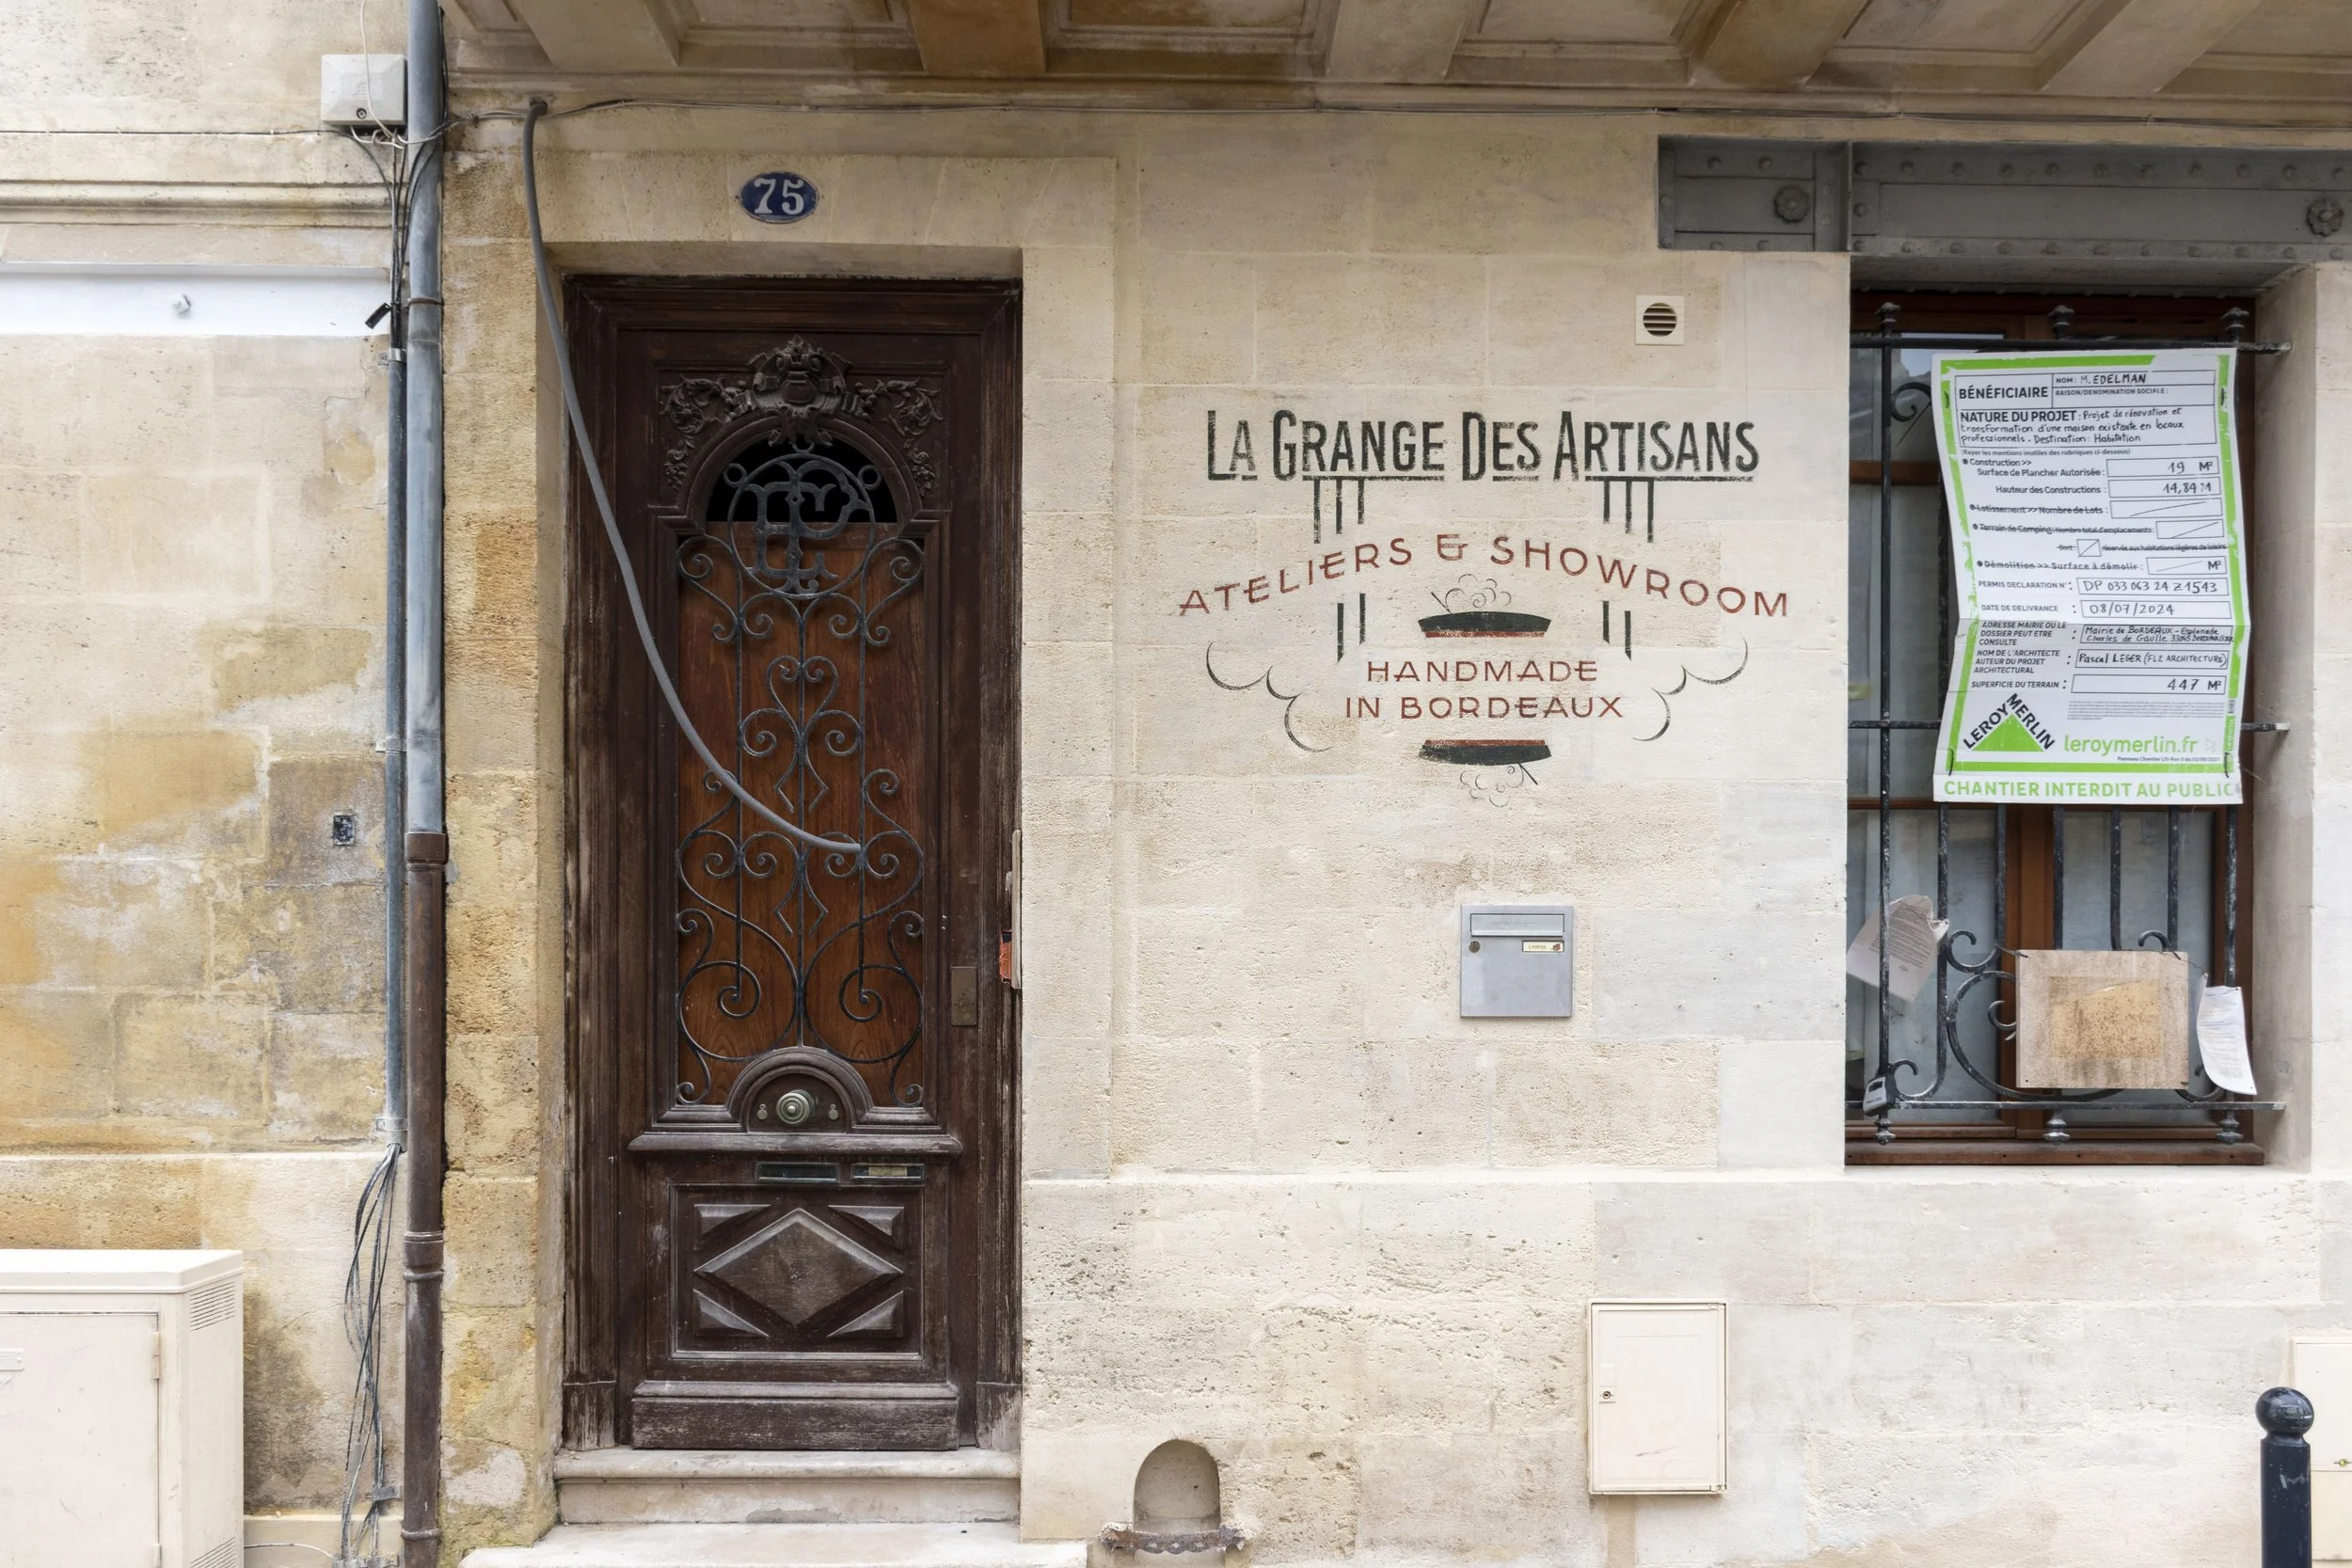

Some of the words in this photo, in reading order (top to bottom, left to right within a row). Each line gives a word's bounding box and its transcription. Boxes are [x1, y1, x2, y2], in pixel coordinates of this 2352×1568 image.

[754, 178, 804, 214] 75
[2093, 373, 2147, 384] EDELMAN
[1959, 385, 2048, 399] BÉNÉFICIAIRE
[1960, 412, 2009, 422] NATURE
[2011, 411, 2028, 421] DU
[2083, 410, 2109, 421] Projet
[2112, 409, 2122, 418] de
[2124, 407, 2168, 418] rénovation
[1961, 424, 2033, 434] transformation
[2037, 423, 2061, 433] d'une
[2098, 420, 2137, 432] existante
[2139, 422, 2152, 431] en
[2155, 418, 2185, 430] locaux
[2093, 433, 2141, 443] Habitation
[1273, 410, 1445, 481] GRANGE
[1462, 411, 1542, 482] DES
[1553, 411, 1759, 482] ARTISANS
[1969, 458, 2021, 467] Construction
[2168, 461, 2185, 474] 19
[1977, 467, 2009, 477] Surface
[2010, 468, 2020, 477] de
[2022, 468, 2058, 477] Plancher
[1995, 485, 2028, 494] Hauteur
[2029, 485, 2043, 494] des
[1180, 537, 1412, 616] ATELIERS
[1489, 536, 1788, 617] SHOWROOM
[2083, 579, 2103, 592] DP
[2107, 580, 2127, 592] 033
[2131, 580, 2150, 592] 063
[2154, 580, 2169, 592] 24
[2089, 601, 2175, 616] 08/07/2024
[1981, 621, 2016, 629] ADRESSE
[2017, 621, 2044, 629] MAIRIE
[2085, 626, 2114, 635] Mairie
[2116, 626, 2125, 635] de
[1979, 629, 2012, 638] DOSSIER
[2013, 629, 2033, 638] PEUT
[2034, 629, 2053, 638] ETRE
[2086, 634, 2118, 642] Charles
[2136, 634, 2169, 642] Gaulle
[1979, 638, 2018, 646] CONSULTE
[1975, 657, 2004, 666] AUTEUR
[2005, 657, 2016, 666] DU
[2017, 657, 2046, 666] PROJET
[2078, 653, 2109, 663] Pascal
[1367, 660, 1598, 683] HANDMADE
[1974, 666, 2035, 674] ARCHITECTURAL
[1971, 680, 2014, 689] SUPERFICIE
[2167, 678, 2200, 690] 447
[1345, 697, 1379, 719] IN
[1401, 696, 1624, 720] BORDEAUX
[1963, 703, 2010, 750] LEROY
[2006, 692, 2056, 751] MERLIN
[2063, 735, 2199, 756] leroymerlin.fr
[1944, 781, 2040, 797] CHANTIER
[2045, 782, 2132, 798] INTERDIT
[2136, 783, 2161, 798] AU
[2167, 783, 2235, 798] PUBLIC
